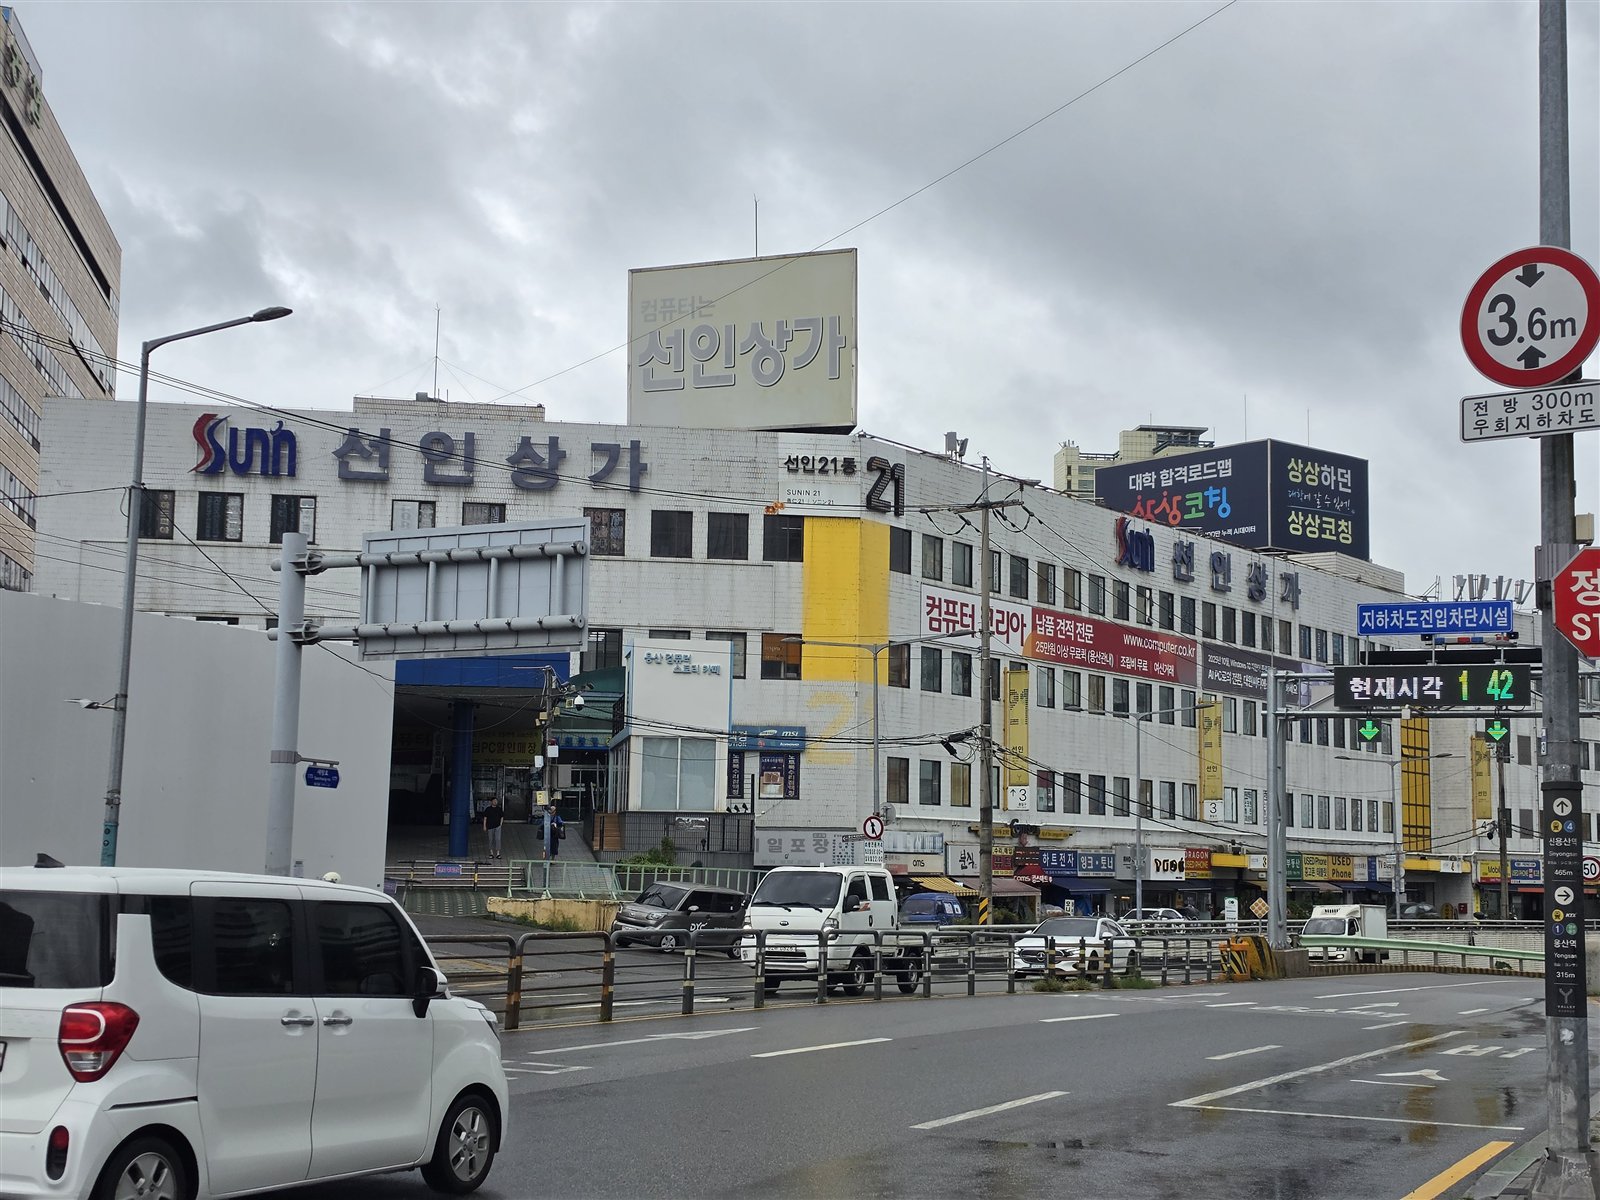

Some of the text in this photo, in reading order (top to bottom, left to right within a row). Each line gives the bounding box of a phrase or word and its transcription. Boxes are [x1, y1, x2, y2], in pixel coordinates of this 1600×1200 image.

[640, 295, 716, 323] 컴퓨터는
[1487, 293, 1577, 346] 3.6m
[638, 315, 847, 392] 선인상가
[1532, 390, 1593, 411] 300m
[1473, 408, 1595, 435] 우회지하차도
[783, 454, 857, 475] 선인21동
[1128, 458, 1232, 491] 대학 합격로드맵
[1287, 457, 1352, 494] 상상하던
[786, 488, 811, 496] SUNIN
[866, 455, 905, 517] 21
[1287, 510, 1353, 545] 상상코칭
[1361, 606, 1508, 630] 지하차도진입차단시설
[1035, 613, 1094, 644] 납품 견적 전문
[1035, 640, 1056, 656] 25만원
[1056, 643, 1069, 658] 이상
[1123, 633, 1195, 658] www.computer.co.kr
[1137, 658, 1148, 672] 무료
[1350, 676, 1443, 700] 현재시각
[1486, 669, 1514, 701] 42
[1206, 765, 1218, 773] 선인
[1018, 788, 1027, 802] 3
[1209, 802, 1217, 814] 3
[1566, 822, 1573, 830] 4
[1042, 853, 1074, 867] 하트전자
[1184, 850, 1209, 859] DRAGON
[1331, 855, 1351, 866] USED
[1331, 868, 1352, 878] Phone
[1583, 862, 1597, 876] 50
[1555, 925, 1560, 933] 1
[1553, 938, 1577, 948] 용산역
[1556, 971, 1576, 979] 315m
